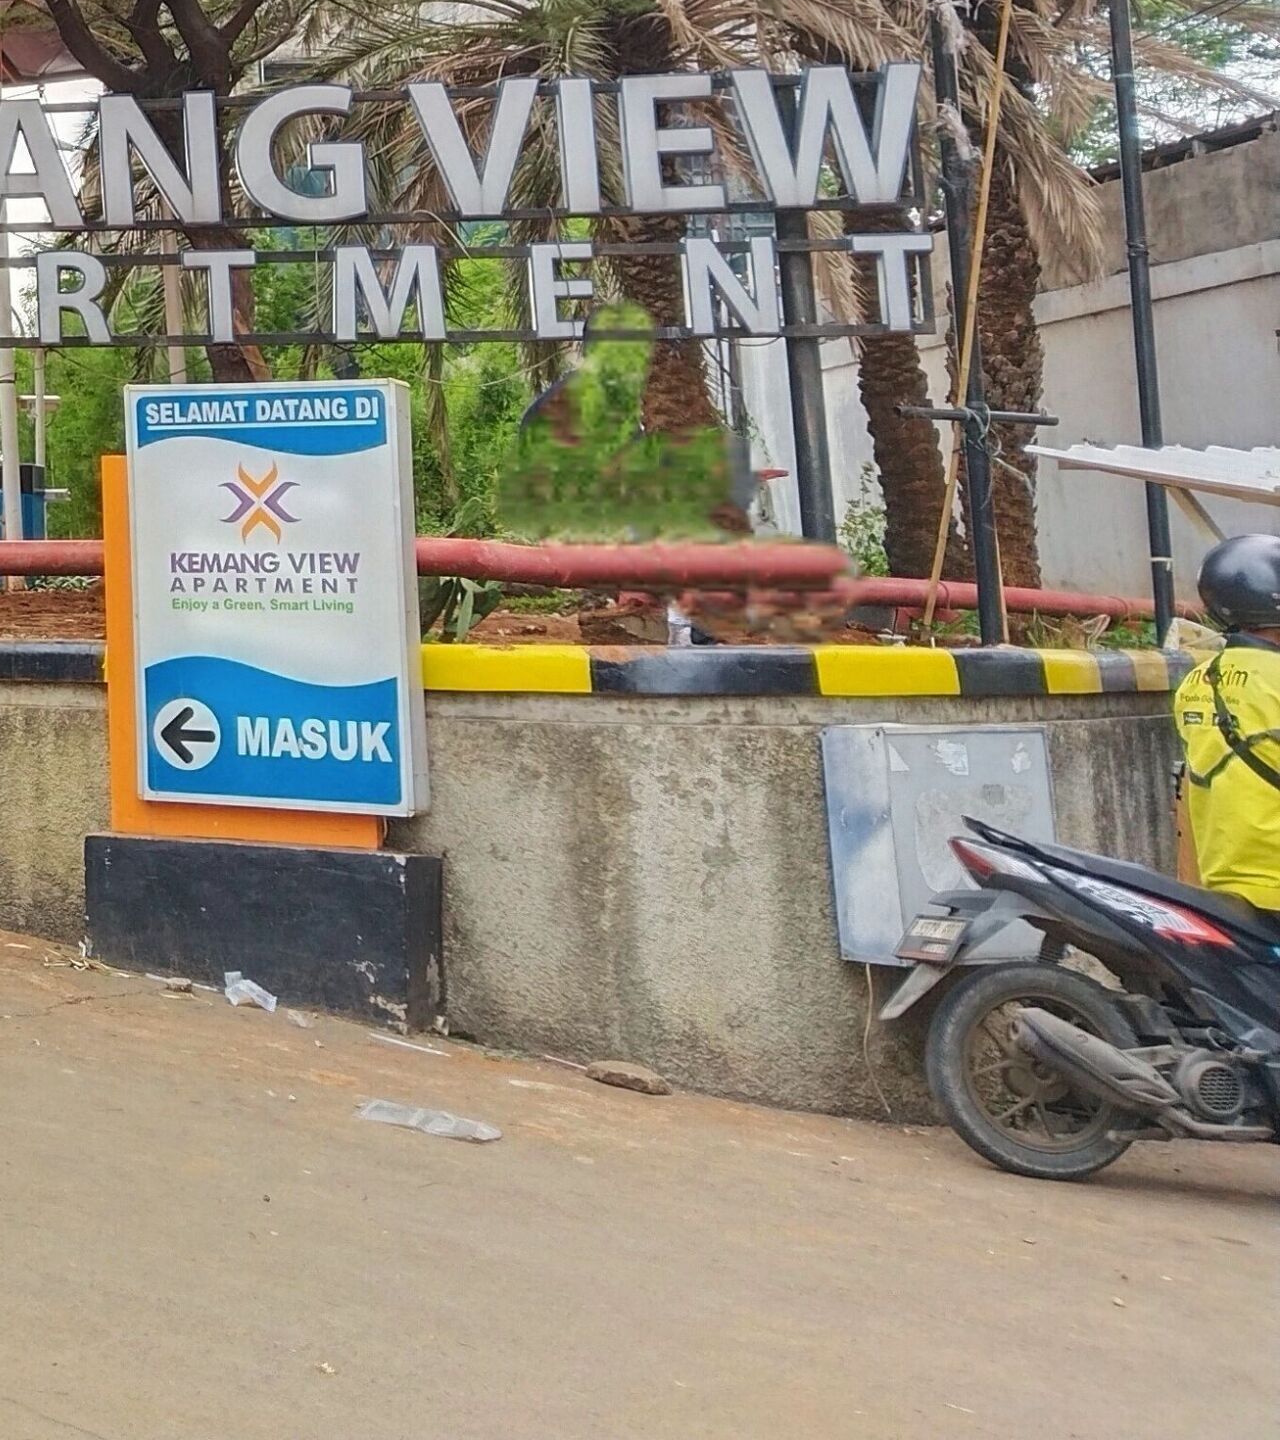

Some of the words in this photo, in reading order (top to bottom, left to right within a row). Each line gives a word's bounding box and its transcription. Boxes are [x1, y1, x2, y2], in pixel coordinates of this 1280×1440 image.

[408, 63, 921, 217] VIEW
[146, 400, 248, 425] SELAMAT
[255, 397, 348, 422] DATANG
[355, 396, 379, 419] DI
[170, 552, 280, 573] KEMANG
[288, 552, 360, 573] VIEW
[170, 577, 358, 593] APARTMENT
[172, 598, 208, 612] Enjoy
[212, 600, 219, 610] a
[270, 598, 309, 611] Smart
[313, 600, 354, 613] Living
[237, 716, 392, 763] MASUK
